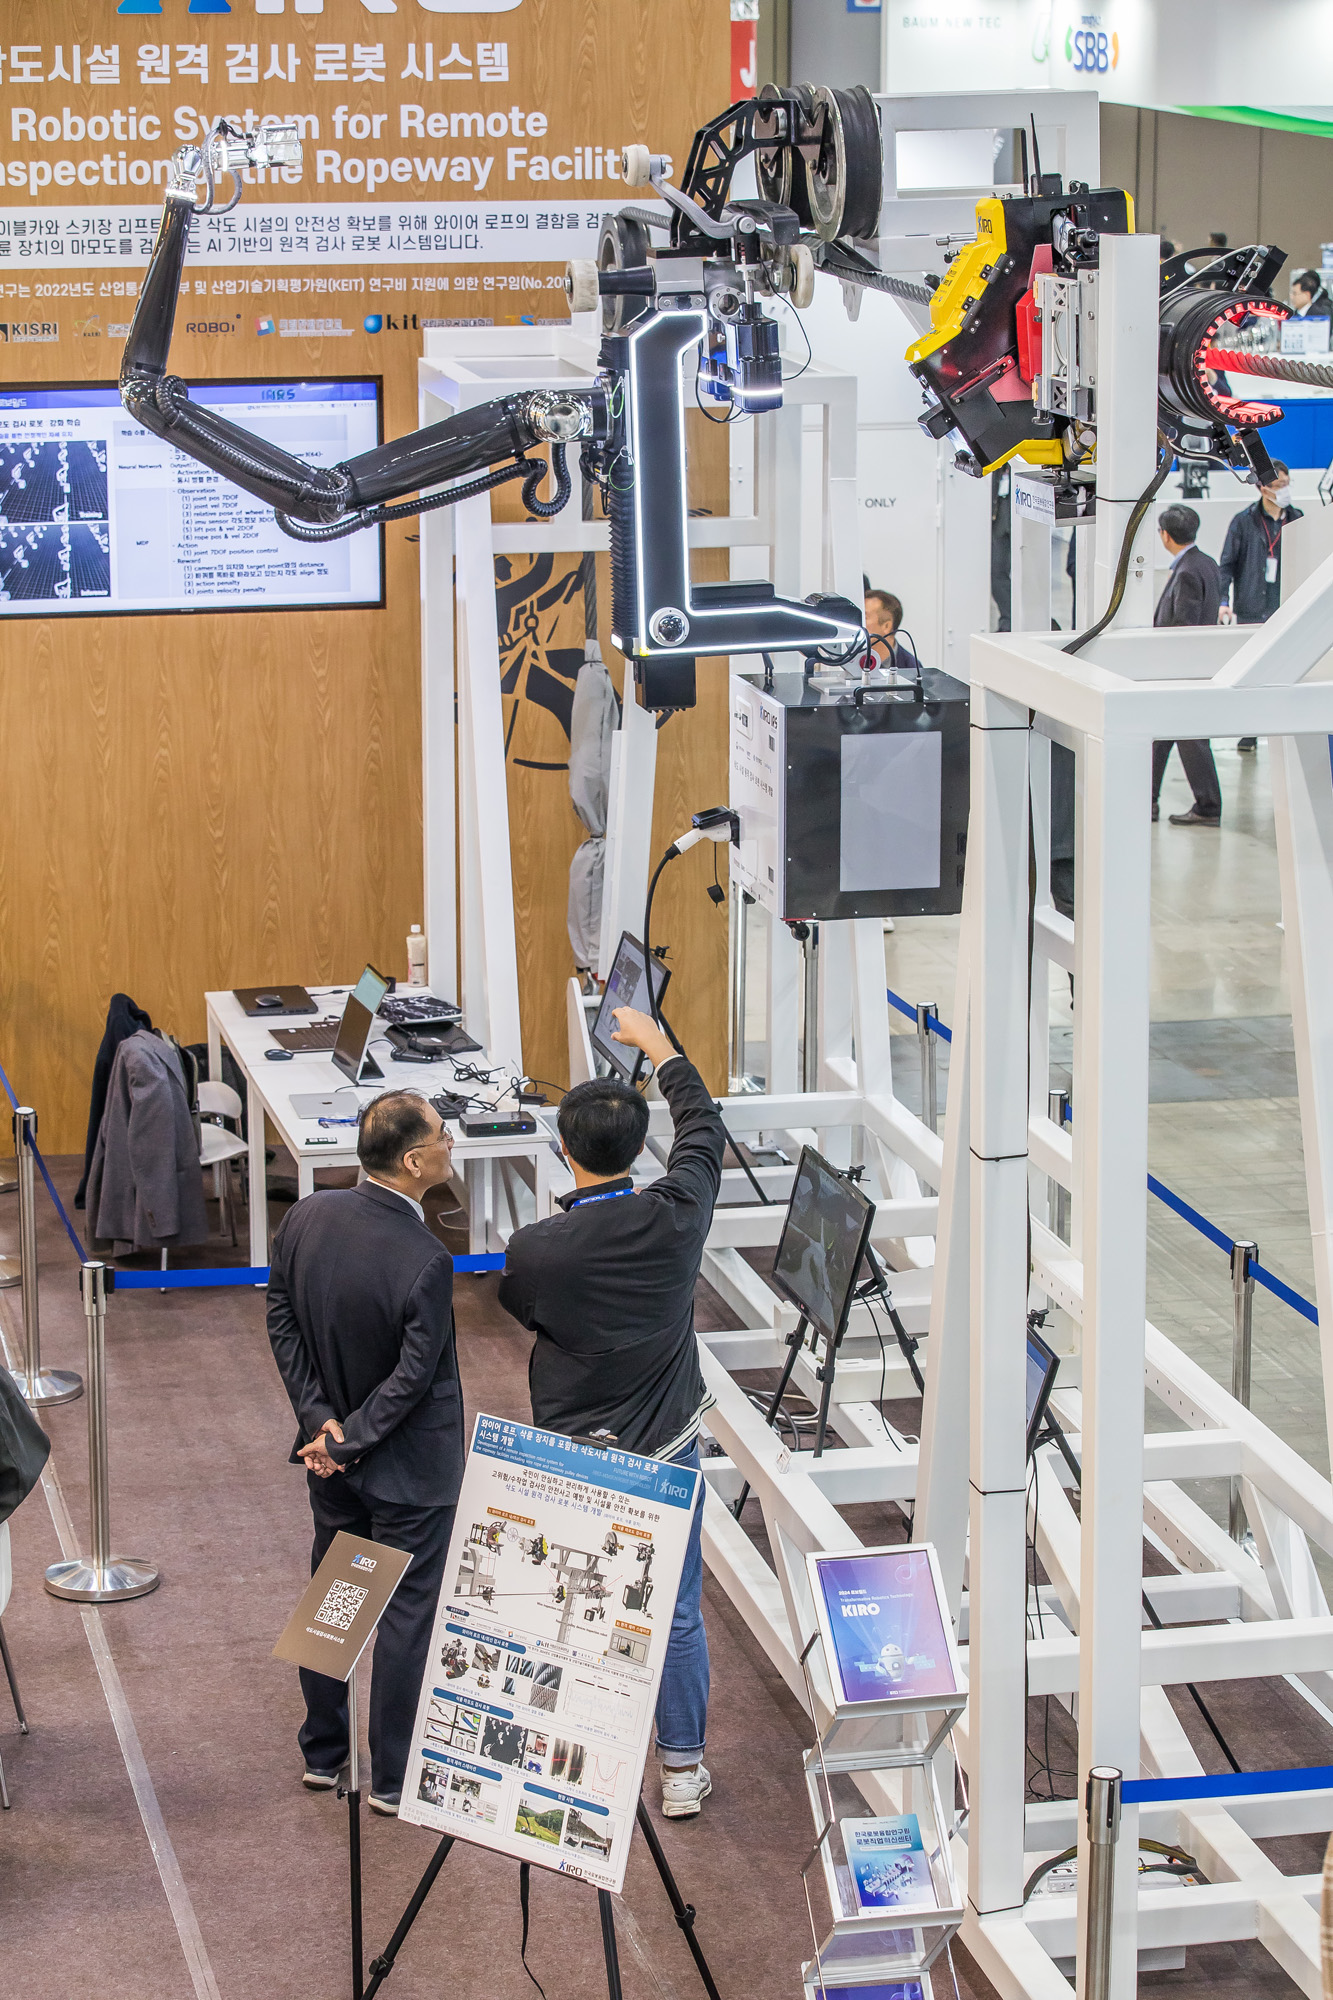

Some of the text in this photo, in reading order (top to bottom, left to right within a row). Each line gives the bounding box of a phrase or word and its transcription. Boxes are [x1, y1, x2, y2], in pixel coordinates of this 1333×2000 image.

[903, 16, 938, 28] BAUM
[1073, 30, 1108, 73] SBB
[0, 42, 509, 84] 도시설 원격 검사 로봇 시스템
[11, 107, 161, 141] Robotic
[332, 105, 387, 139] for
[400, 104, 547, 139] Remote
[0, 152, 175, 196] spection
[316, 149, 494, 193] Ropeway
[507, 146, 674, 181] Facilits
[66, 219, 112, 235] 스키장
[207, 217, 236, 233] 삭도
[244, 216, 288, 232] 시설의
[295, 216, 340, 232] 안전성
[347, 215, 392, 232] 확보를
[398, 215, 427, 231] 위해
[434, 214, 478, 230] 와이어
[485, 214, 529, 229] 로프의
[536, 213, 580, 229] 결함을
[18, 240, 64, 256] 장치의
[71, 239, 133, 255] 마모도를
[140, 238, 201, 255] 검는
[207, 238, 222, 252] AI
[228, 237, 272, 252] 기반의
[280, 237, 309, 252] 원격
[316, 236, 345, 252] 검사
[352, 236, 381, 251] 로봇
[387, 234, 484, 251] 시스템입니다.
[35, 282, 95, 297] 2022년도
[195, 281, 207, 295] 및
[212, 278, 365, 295] 산업기술기획평가원(KEIT)
[369, 277, 407, 293] 연구비
[411, 277, 449, 292] 지원에
[454, 276, 479, 291] 의한
[12, 323, 57, 335] KISRI
[386, 314, 420, 330] kit
[865, 498, 896, 508] ONLY
[479, 1429, 514, 1447] 시스템 개발
[481, 1419, 501, 1432] 와이어
[502, 1424, 518, 1437] 로프,
[535, 1433, 556, 1447] 장치를
[557, 1439, 579, 1453] 포함한
[580, 1445, 609, 1461] 삭도시설
[610, 1453, 625, 1466] 원격
[627, 1457, 642, 1470] 검사
[643, 1462, 659, 1475] 로봇
[659, 1478, 689, 1499] KIRO
[352, 1552, 377, 1568] KIRO
[842, 1603, 880, 1617] KIRO
[559, 1858, 583, 1877] KIRO
